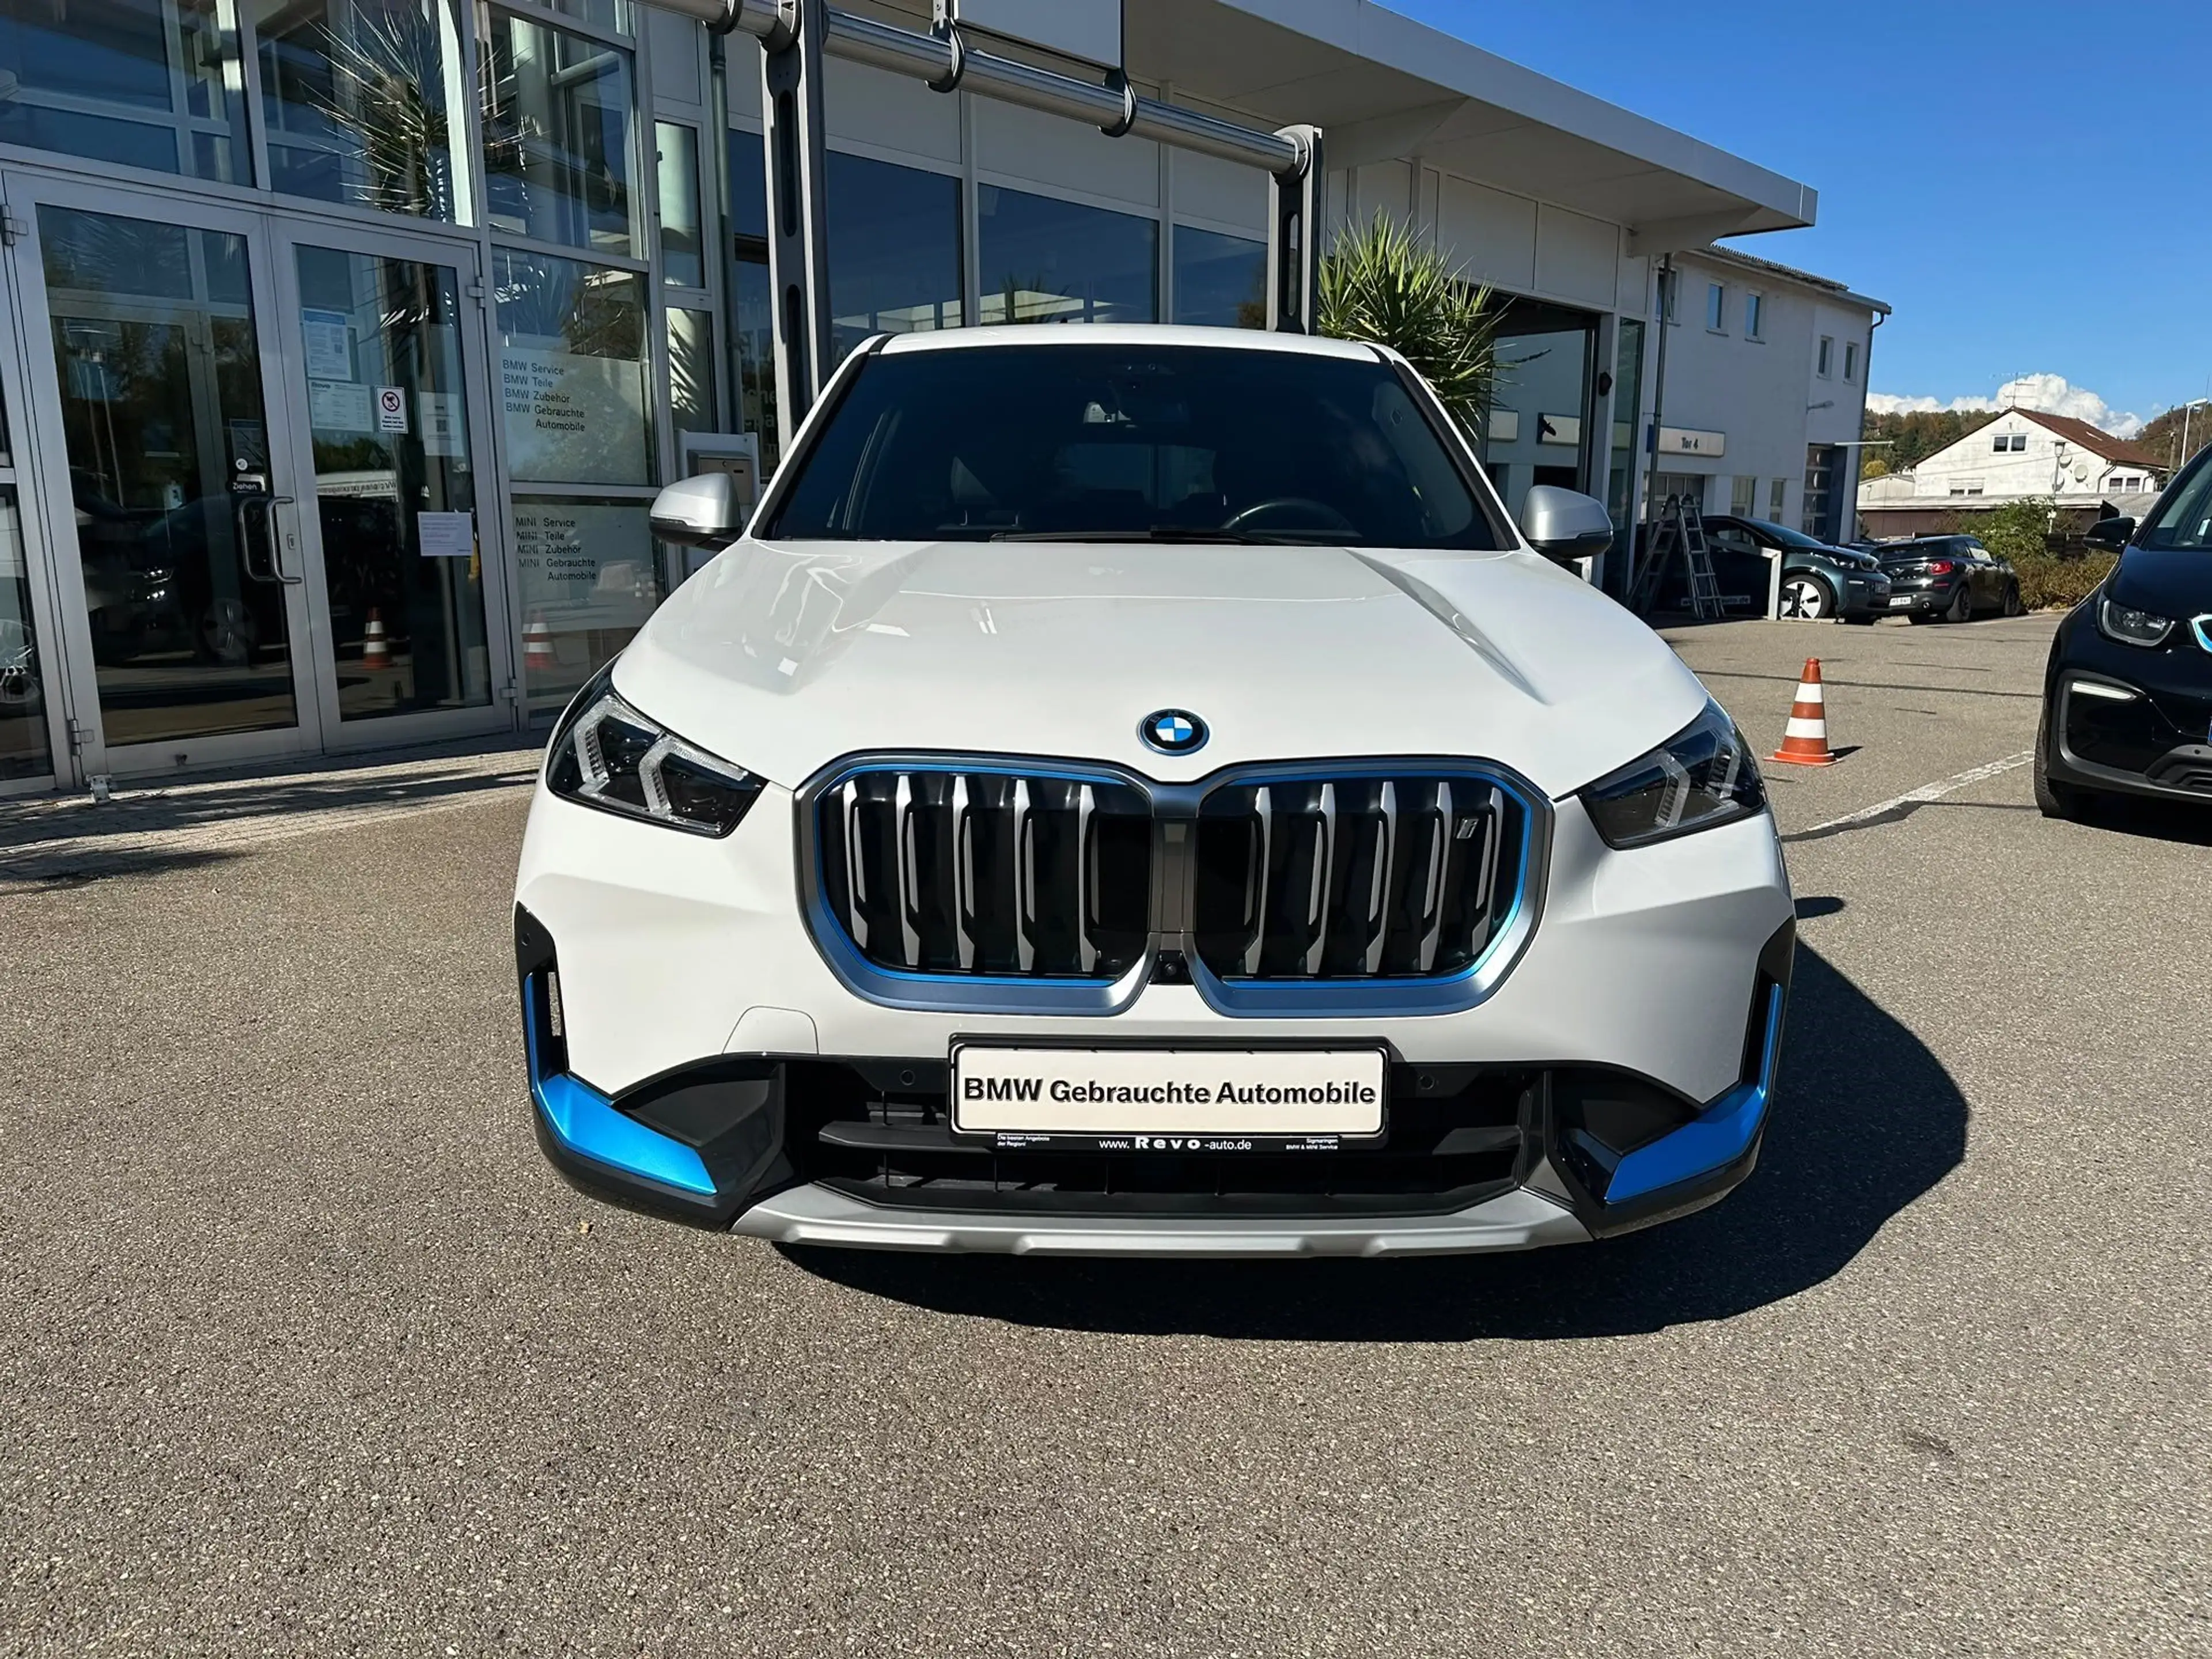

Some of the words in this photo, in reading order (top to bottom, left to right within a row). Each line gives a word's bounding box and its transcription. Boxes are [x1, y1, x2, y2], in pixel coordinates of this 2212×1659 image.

[502, 359, 527, 371] BMW
[531, 363, 564, 375] Service
[503, 374, 528, 385] BMW
[532, 377, 553, 388] Teile
[505, 388, 529, 399] BMW
[533, 391, 570, 403] Zubehör
[506, 402, 530, 413] BMW
[535, 404, 585, 418] Gebrauchte
[536, 418, 585, 431] Automobile
[1681, 437, 1692, 449] Tor
[1694, 438, 1699, 449] 4
[516, 517, 536, 527] MINI
[543, 517, 575, 528] Service
[516, 531, 537, 540] MINI
[544, 531, 565, 540] Teile
[517, 544, 539, 554] MINI
[546, 544, 581, 554] Zubehör
[518, 558, 539, 567] MINI
[546, 558, 596, 567] Gebrauchte
[547, 571, 596, 581] Automobile
[964, 1077, 1044, 1101] BMW
[1050, 1079, 1211, 1104] Gebrauchte
[1215, 1081, 1376, 1104] Automobile
[1099, 1140, 1130, 1149] www.
[1134, 1137, 1201, 1150] Revo
[1204, 1139, 1252, 1150] -auto.de
